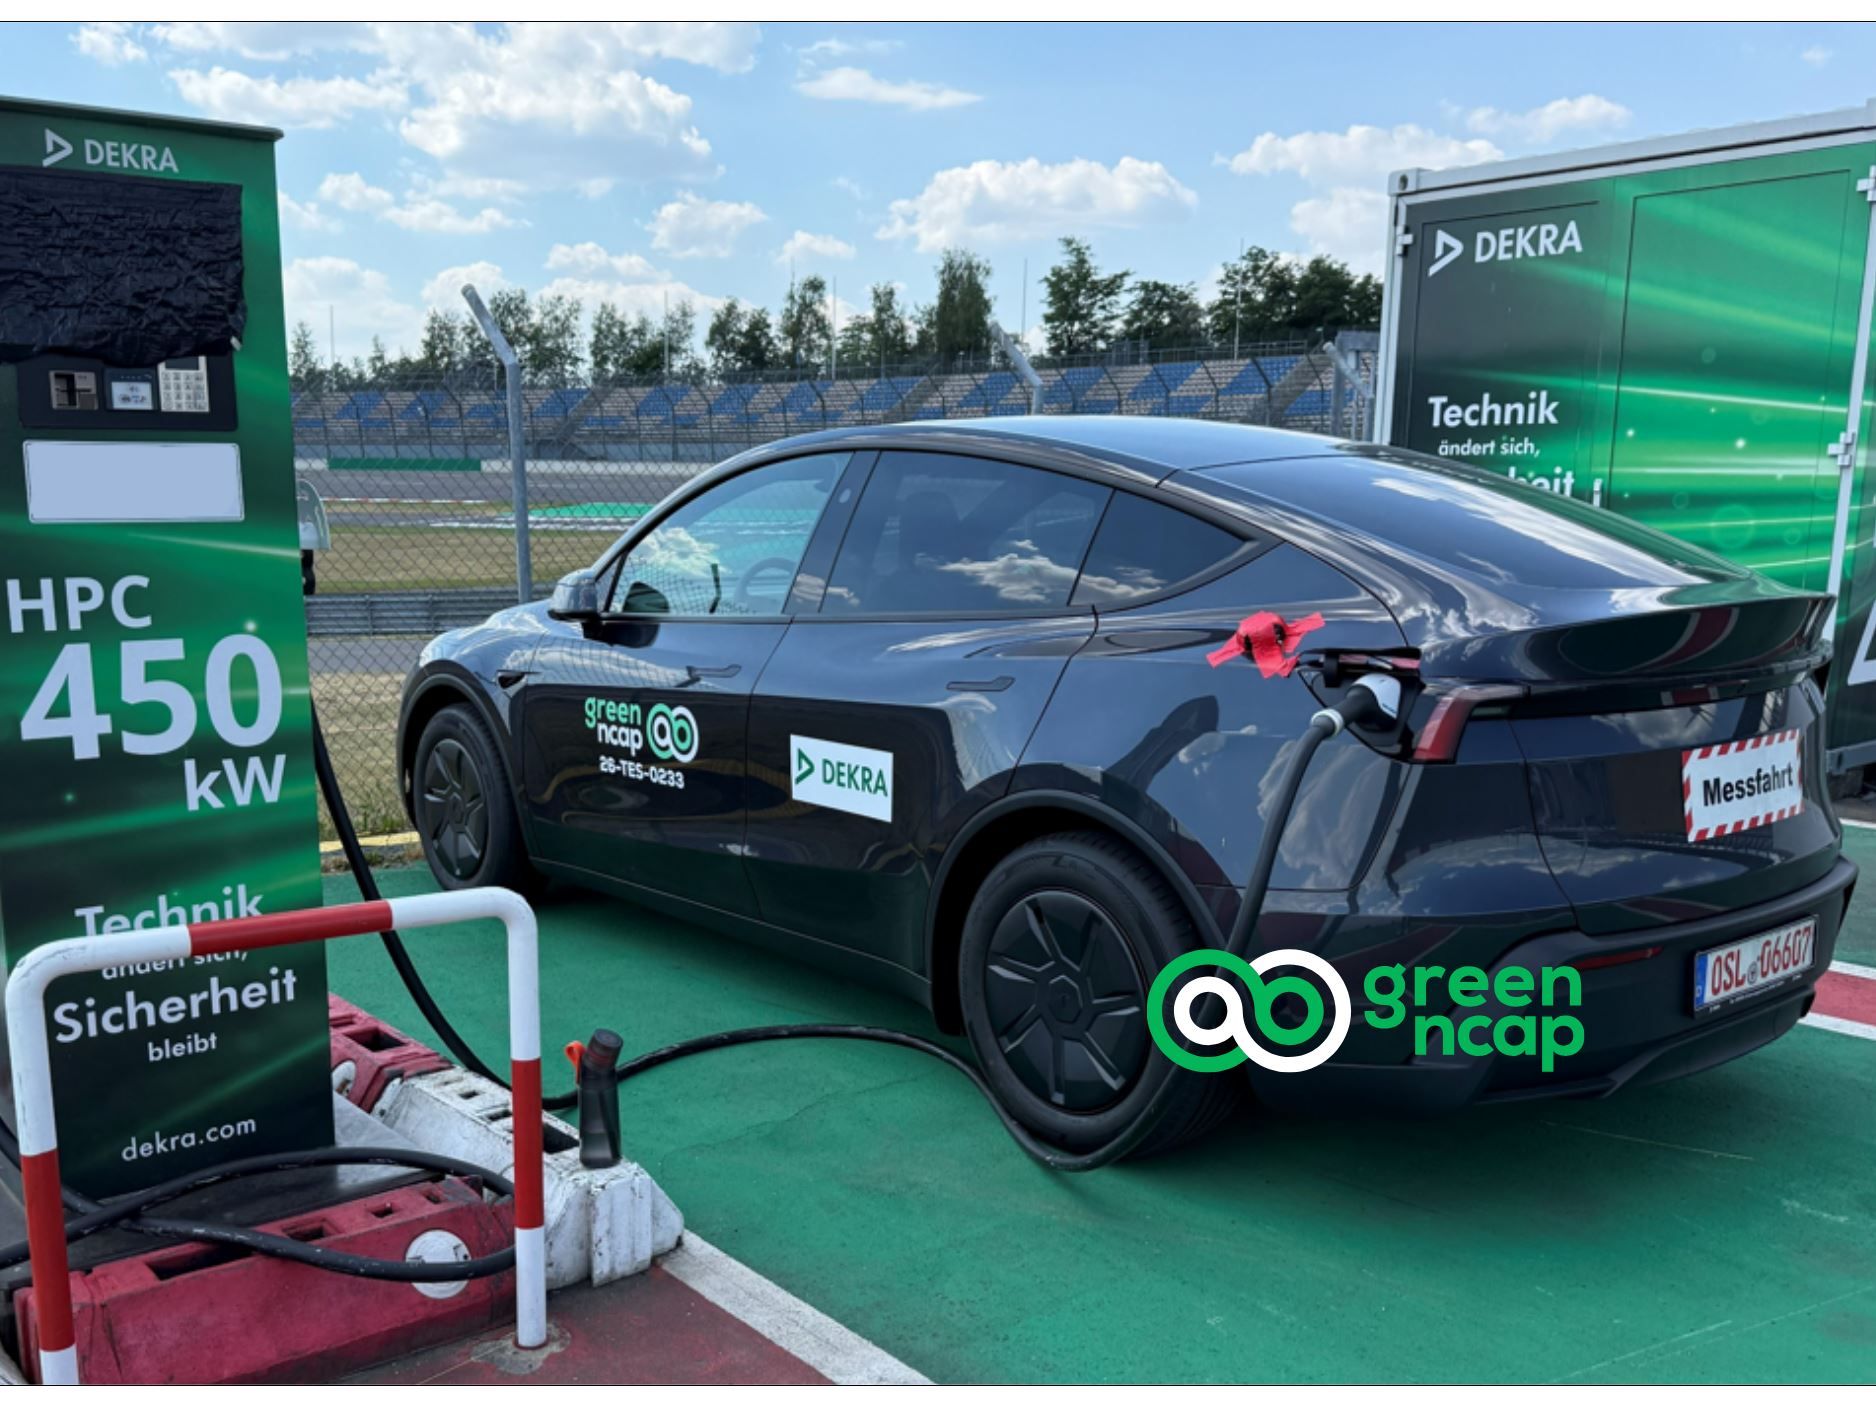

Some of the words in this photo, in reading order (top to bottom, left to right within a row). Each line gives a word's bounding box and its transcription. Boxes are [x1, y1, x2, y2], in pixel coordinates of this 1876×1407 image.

[84, 138, 179, 173] DEKRA
[1474, 220, 1583, 263] DEKRA
[1427, 390, 1560, 428] Technik
[1438, 438, 1496, 456] ändert
[1500, 437, 1541, 457] sich,
[6, 575, 152, 633] HPC
[20, 633, 283, 761] 450
[584, 697, 642, 729] green
[597, 723, 643, 757] ncap
[184, 754, 287, 812] kW
[821, 758, 888, 797] DEKRA
[1703, 762, 1794, 807] Messfahrt
[74, 884, 265, 937] Technik
[1711, 948, 1747, 997] OSL
[1760, 926, 1812, 979] 06607
[53, 967, 297, 1044] Sicherheit
[147, 1032, 218, 1062] bleibt
[121, 1118, 256, 1162] dekra.com
